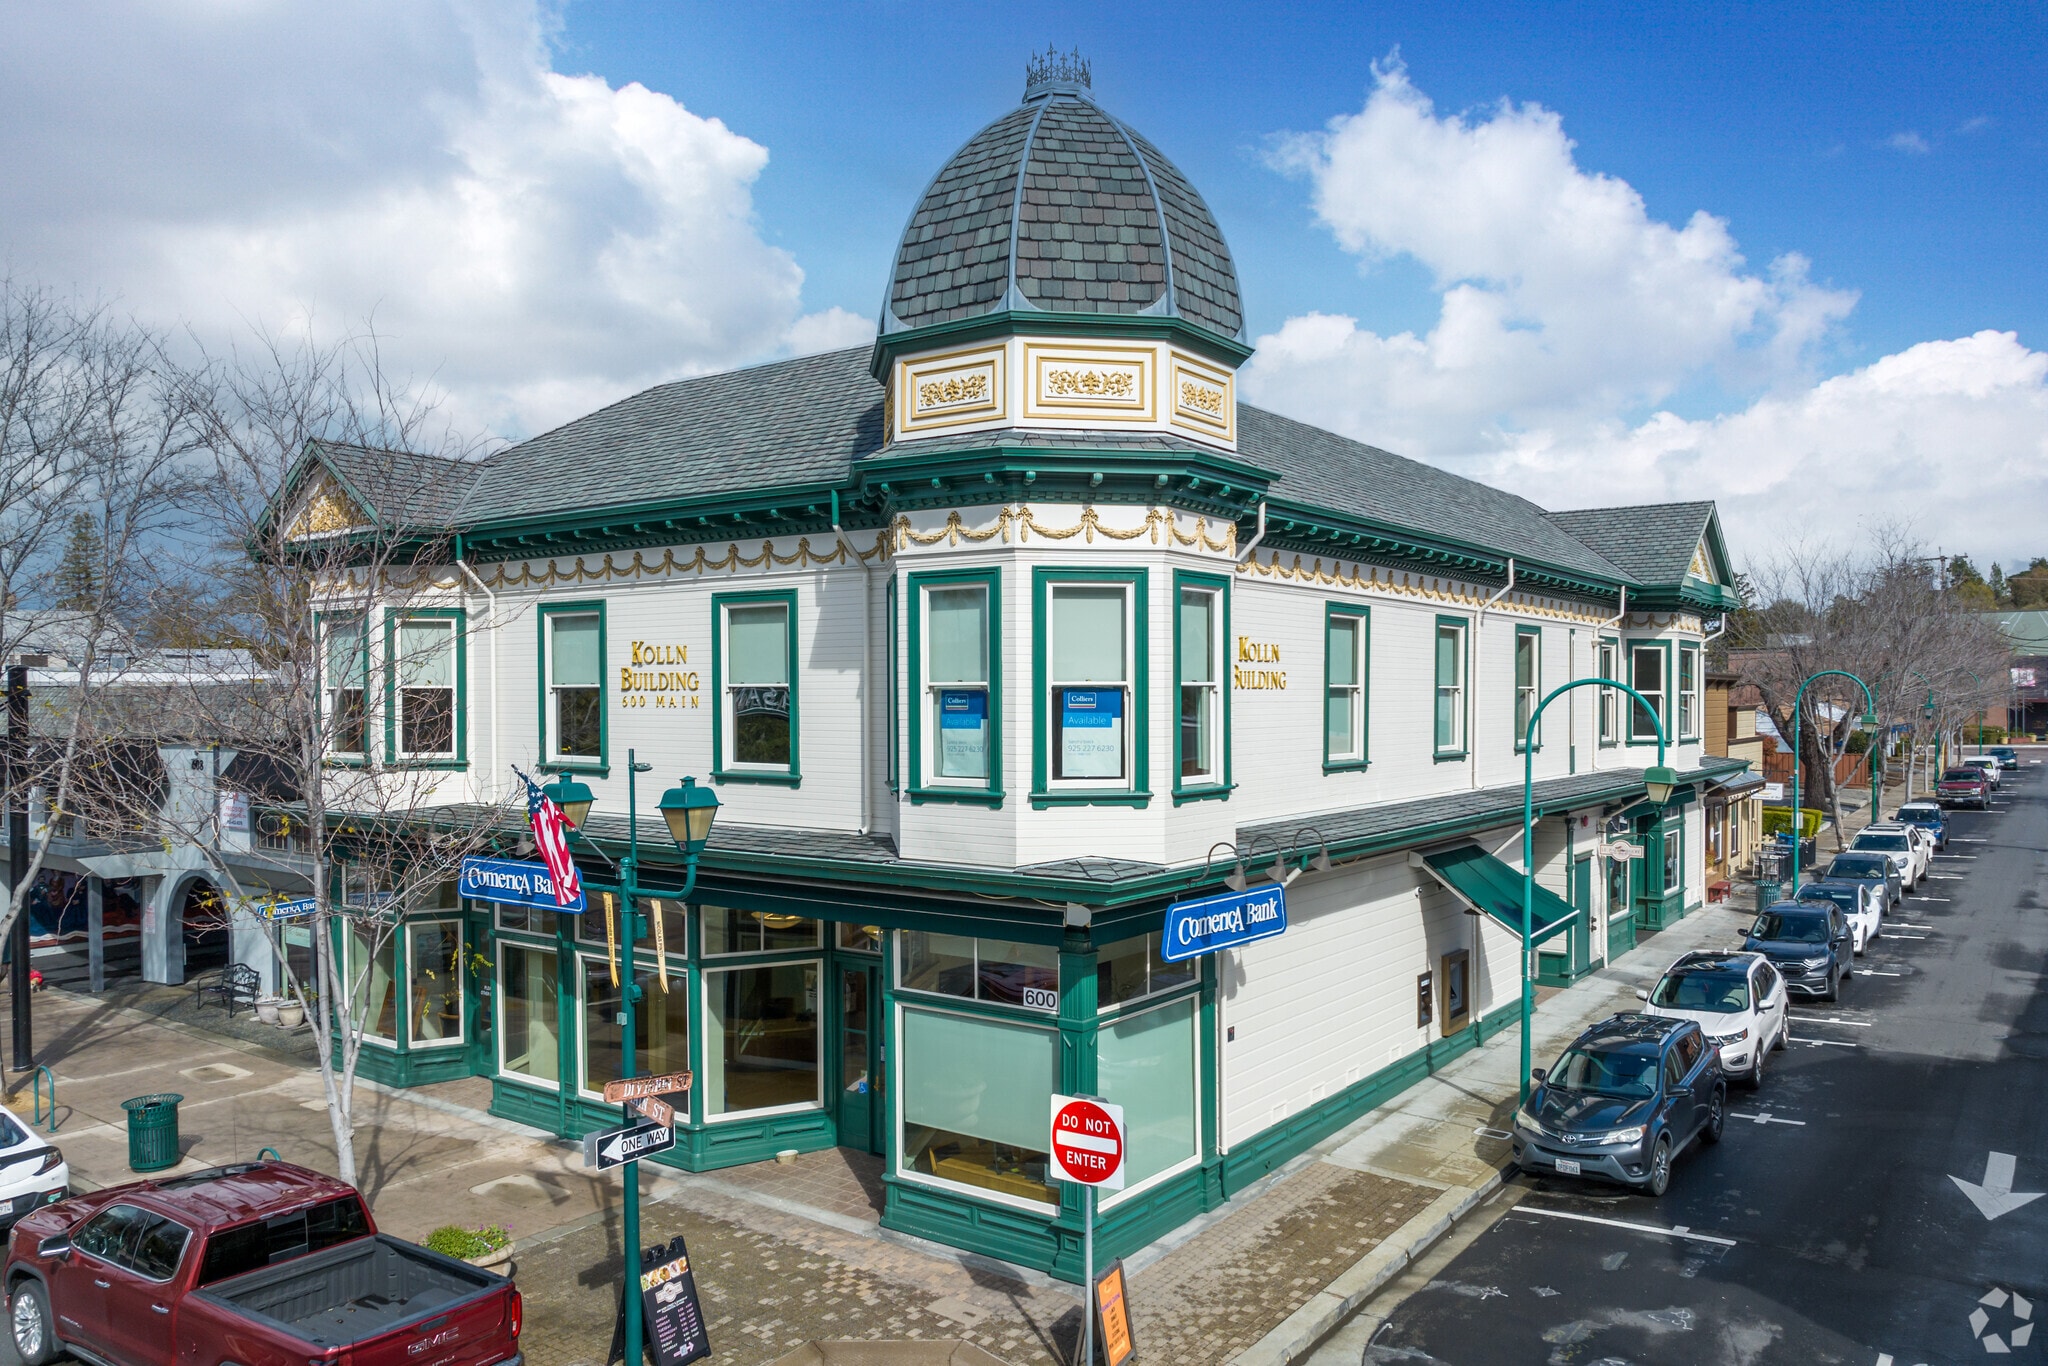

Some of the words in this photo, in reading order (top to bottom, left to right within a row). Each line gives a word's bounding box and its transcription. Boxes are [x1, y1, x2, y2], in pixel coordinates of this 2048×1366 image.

[631, 640, 687, 665] KOLLN
[1238, 636, 1280, 663] KOLLN
[620, 667, 699, 692] BUILDING
[622, 695, 646, 708] 600
[656, 695, 699, 708] MAIN
[946, 718, 977, 726] Available
[1068, 716, 1106, 725] Available
[1246, 897, 1279, 925] Bank
[1026, 990, 1056, 1008] 600
[1062, 1113, 1078, 1129] DO
[1085, 1117, 1111, 1135] NOT
[621, 1136, 642, 1153] ONE
[646, 1128, 667, 1145] WAY
[1066, 1150, 1106, 1171] ENTER
[407, 1326, 460, 1355] GMC
